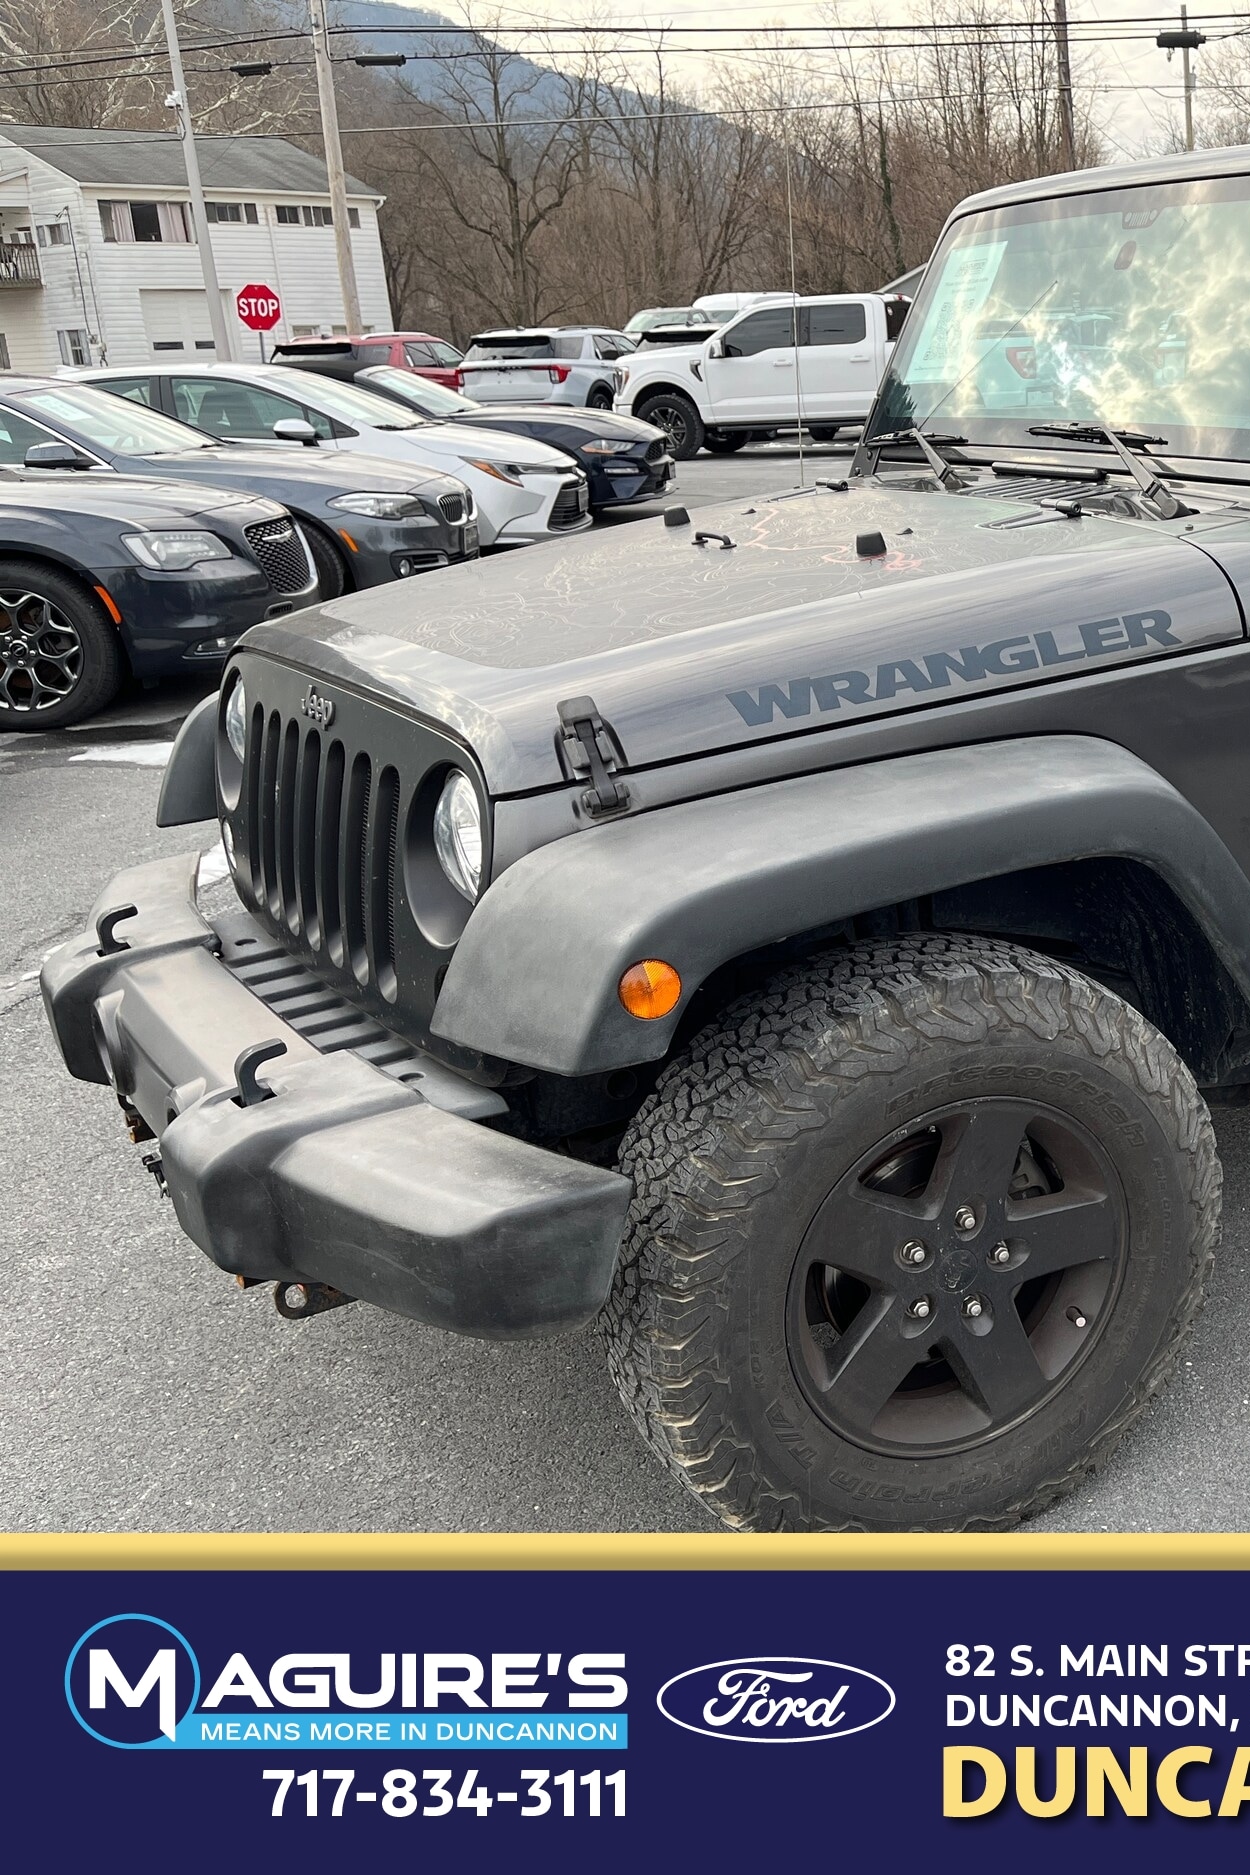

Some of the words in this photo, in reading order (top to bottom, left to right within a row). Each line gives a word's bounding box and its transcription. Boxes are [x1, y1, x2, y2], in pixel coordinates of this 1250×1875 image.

[239, 298, 279, 318] STOP
[725, 609, 1183, 727] WRANGLER
[301, 684, 336, 731] Jeep
